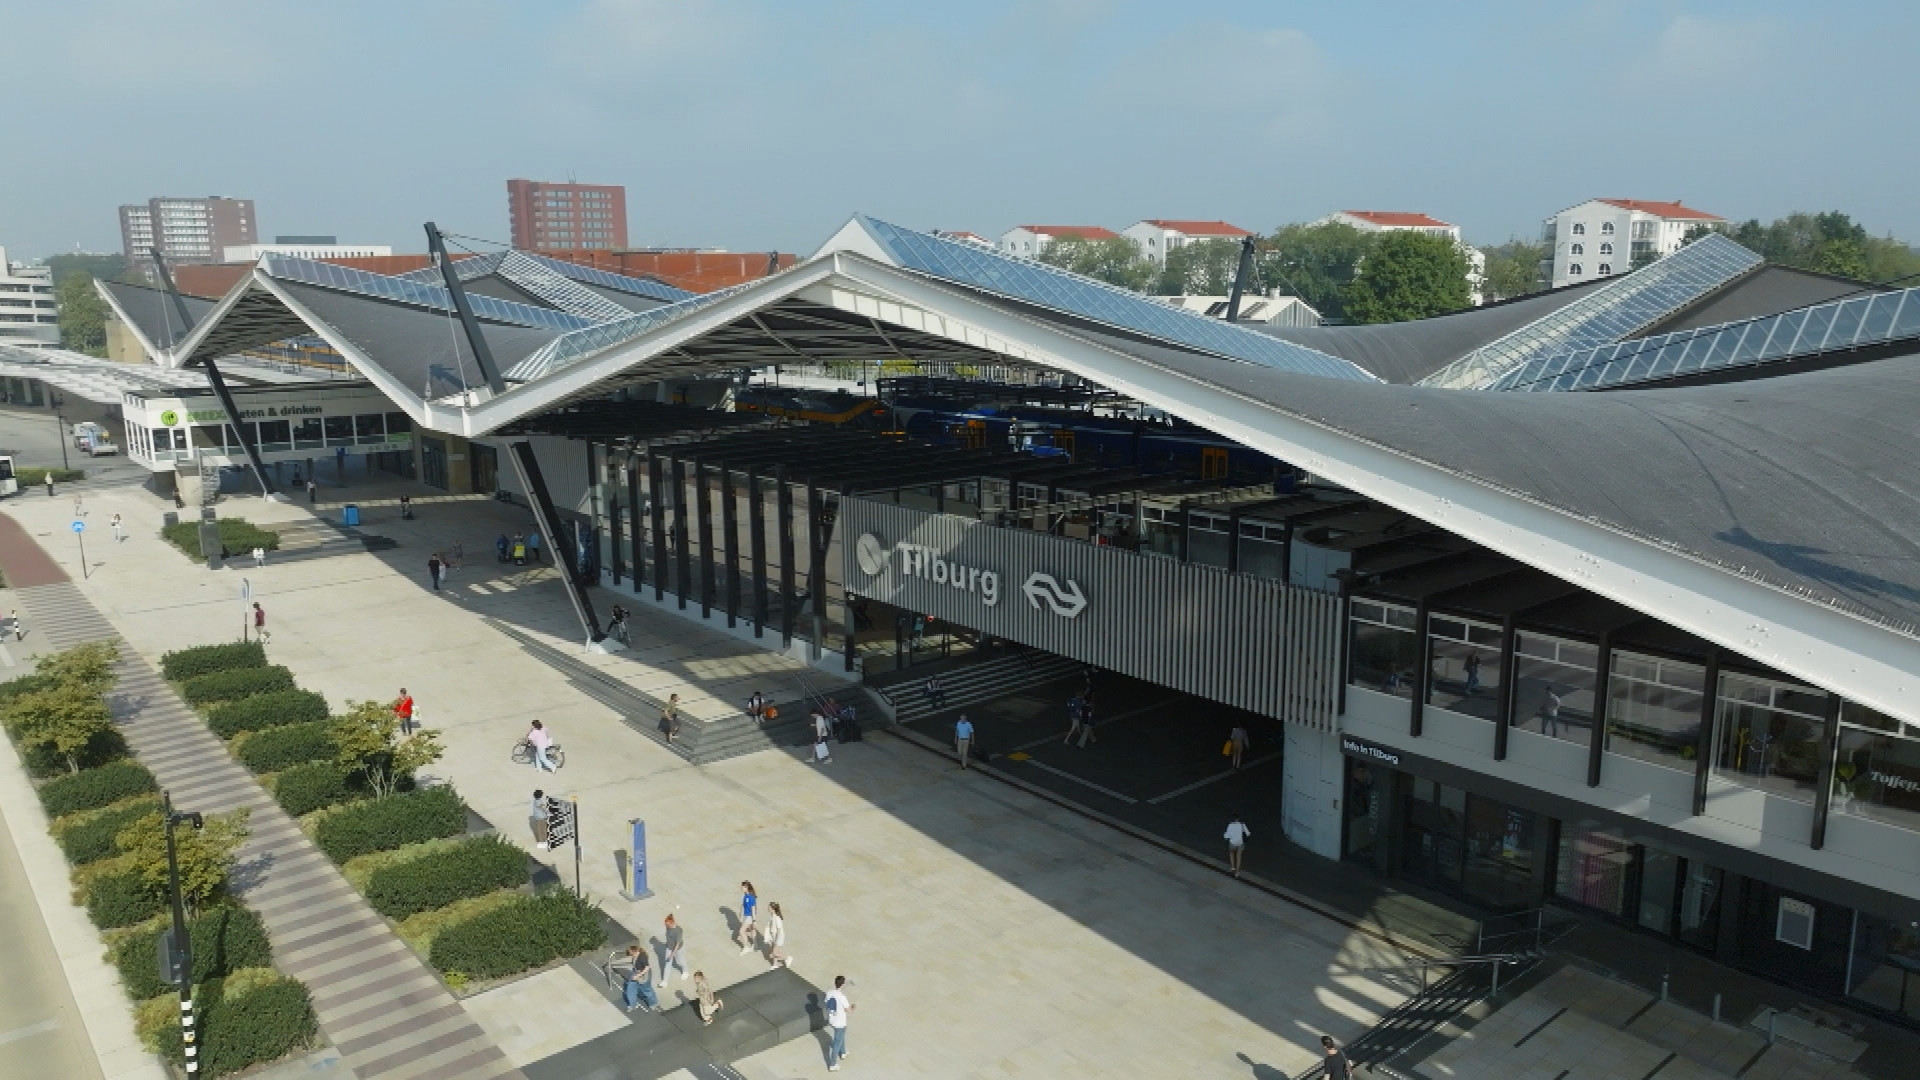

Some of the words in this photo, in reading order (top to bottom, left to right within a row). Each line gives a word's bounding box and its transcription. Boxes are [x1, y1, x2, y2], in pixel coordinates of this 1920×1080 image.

[268, 407, 278, 416] &
[280, 404, 323, 416] drinken
[898, 542, 998, 606] Tilburg
[1344, 739, 1360, 752] Info
[1368, 747, 1399, 765] Tilburg
